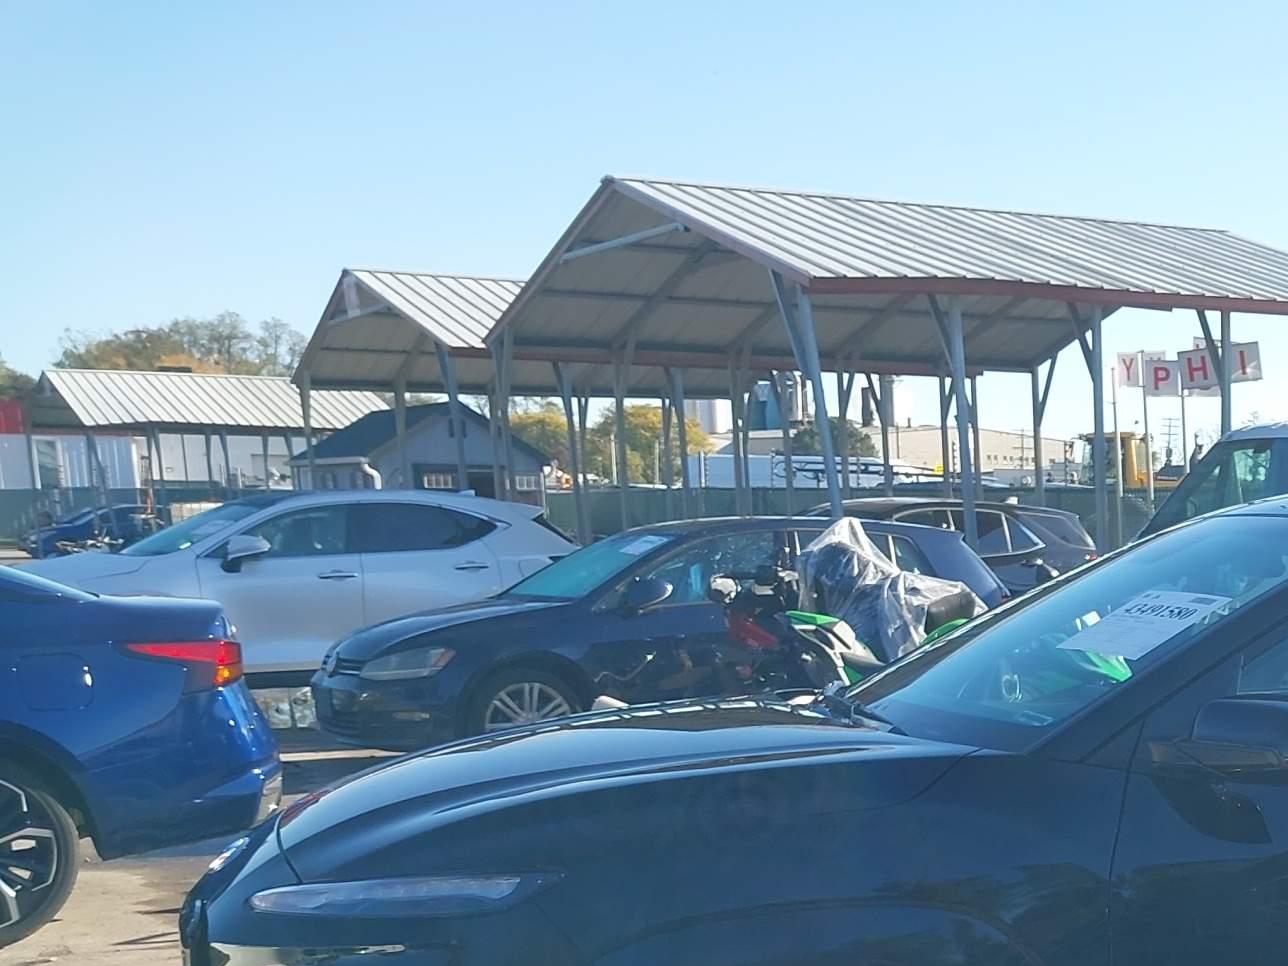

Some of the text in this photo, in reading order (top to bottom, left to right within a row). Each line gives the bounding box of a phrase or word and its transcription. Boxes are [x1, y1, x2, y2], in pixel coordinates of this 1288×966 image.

[1122, 357, 1135, 382] Y
[1154, 366, 1171, 391] P
[1186, 355, 1209, 382] H
